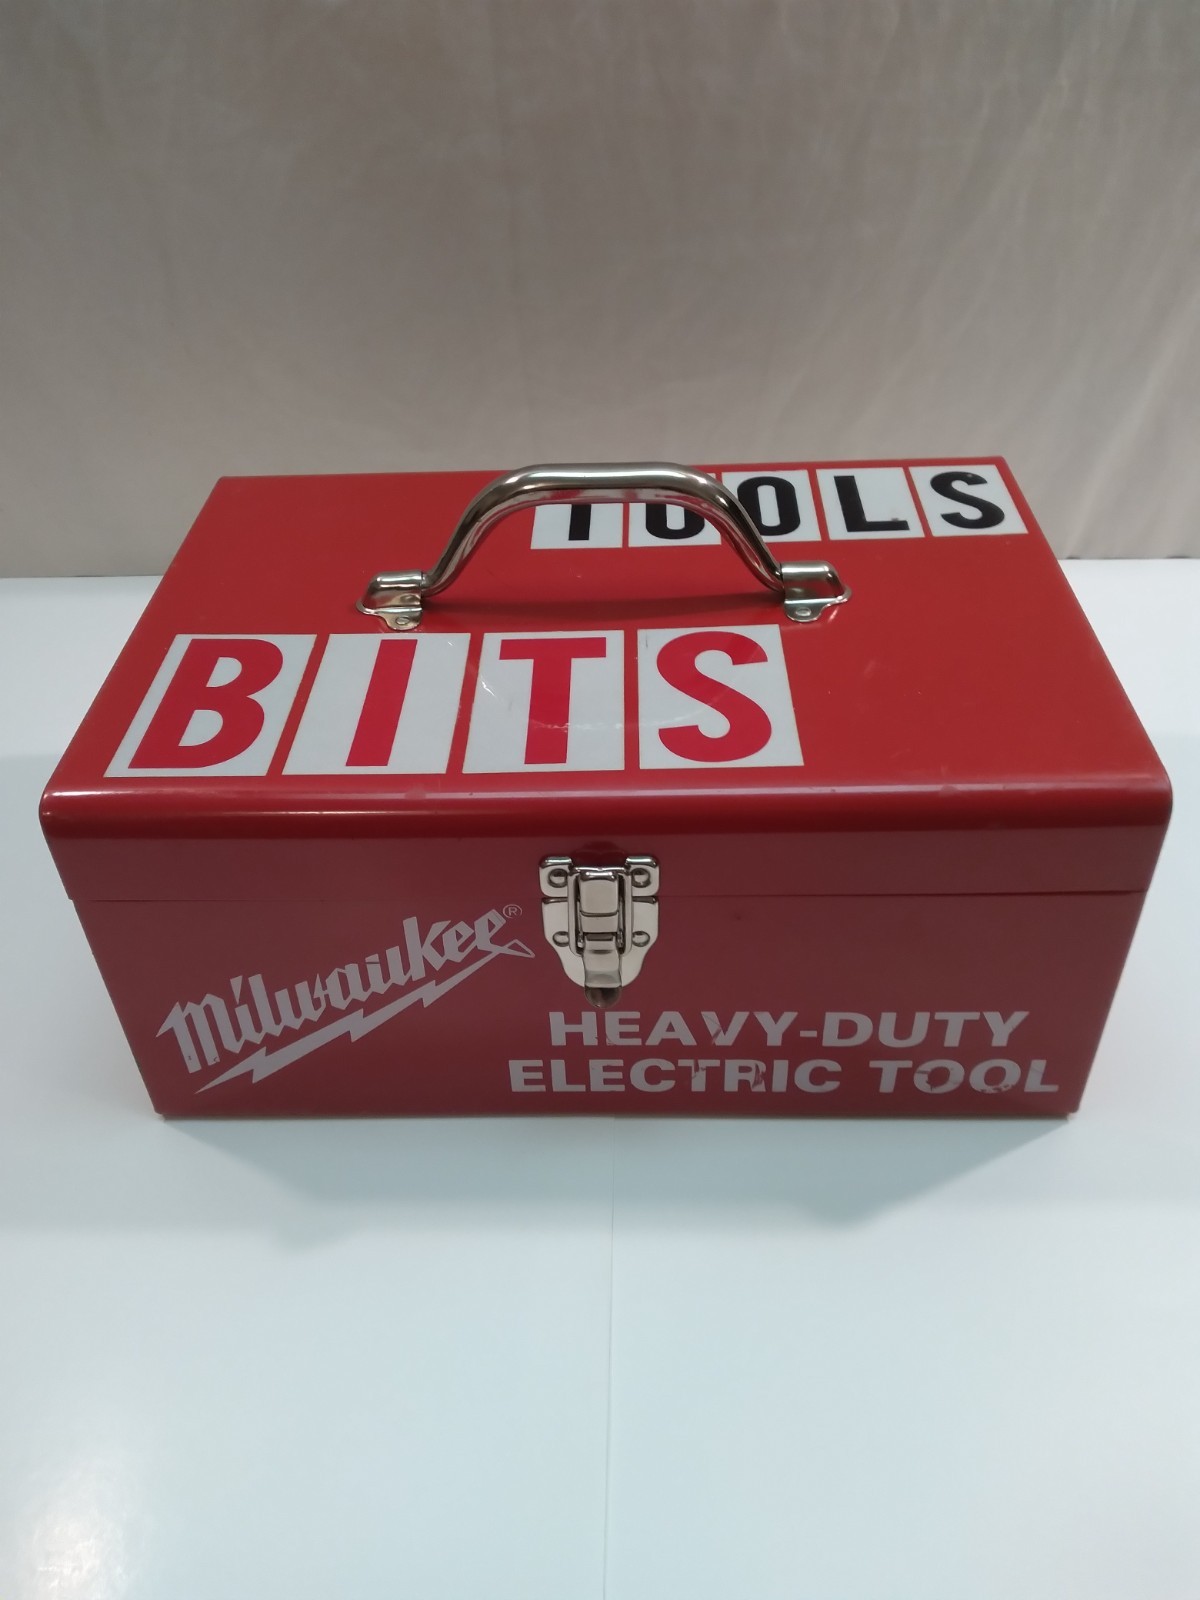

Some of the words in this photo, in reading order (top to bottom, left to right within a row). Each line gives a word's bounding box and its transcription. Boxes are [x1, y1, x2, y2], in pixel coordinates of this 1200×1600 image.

[127, 630, 772, 769] BITS
[549, 1010, 1030, 1048] HEAVY-DUTY
[508, 1059, 842, 1093] ELECTRIC
[868, 1059, 1060, 1093] TOOL
